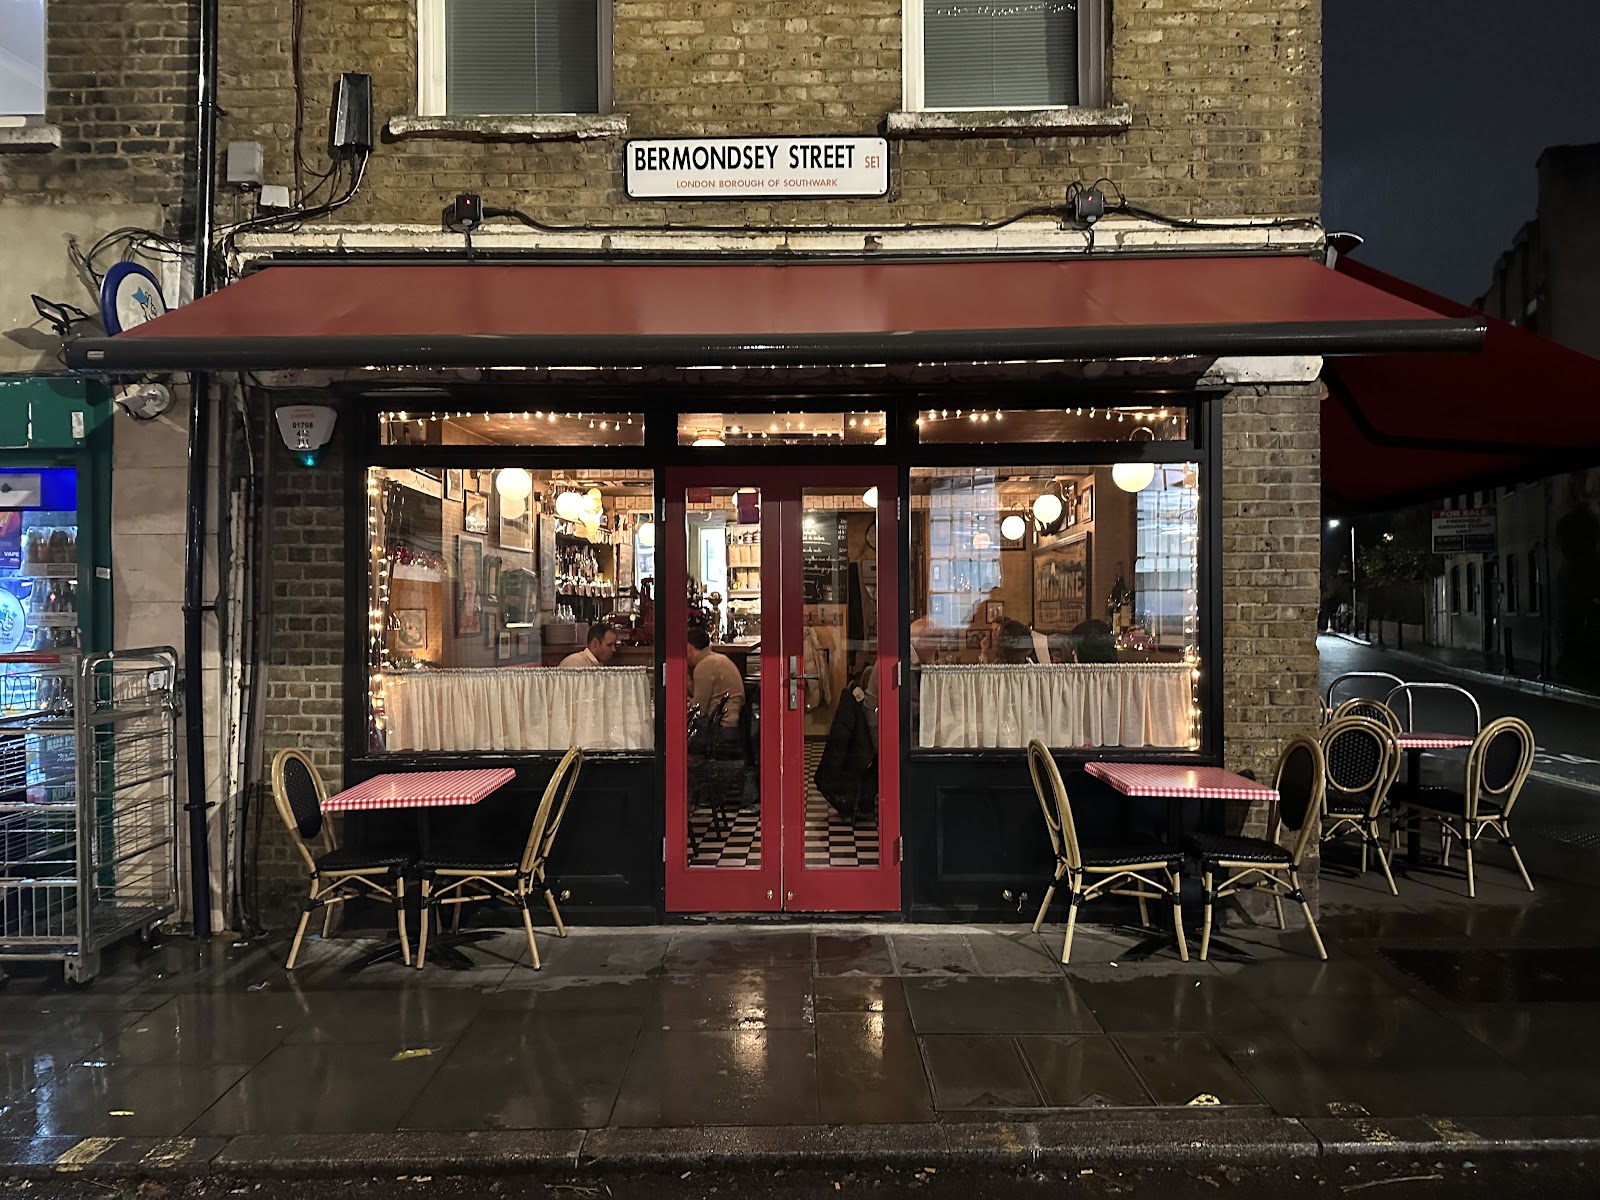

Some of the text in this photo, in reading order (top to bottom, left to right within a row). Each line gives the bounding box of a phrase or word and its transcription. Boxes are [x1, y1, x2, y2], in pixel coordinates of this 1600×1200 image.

[635, 144, 880, 171] BERMONDSEY STREET SE1
[676, 178, 838, 188] LONDON BOROUGH OF SOUTHWARK
[1462, 509, 1488, 517] SALE
